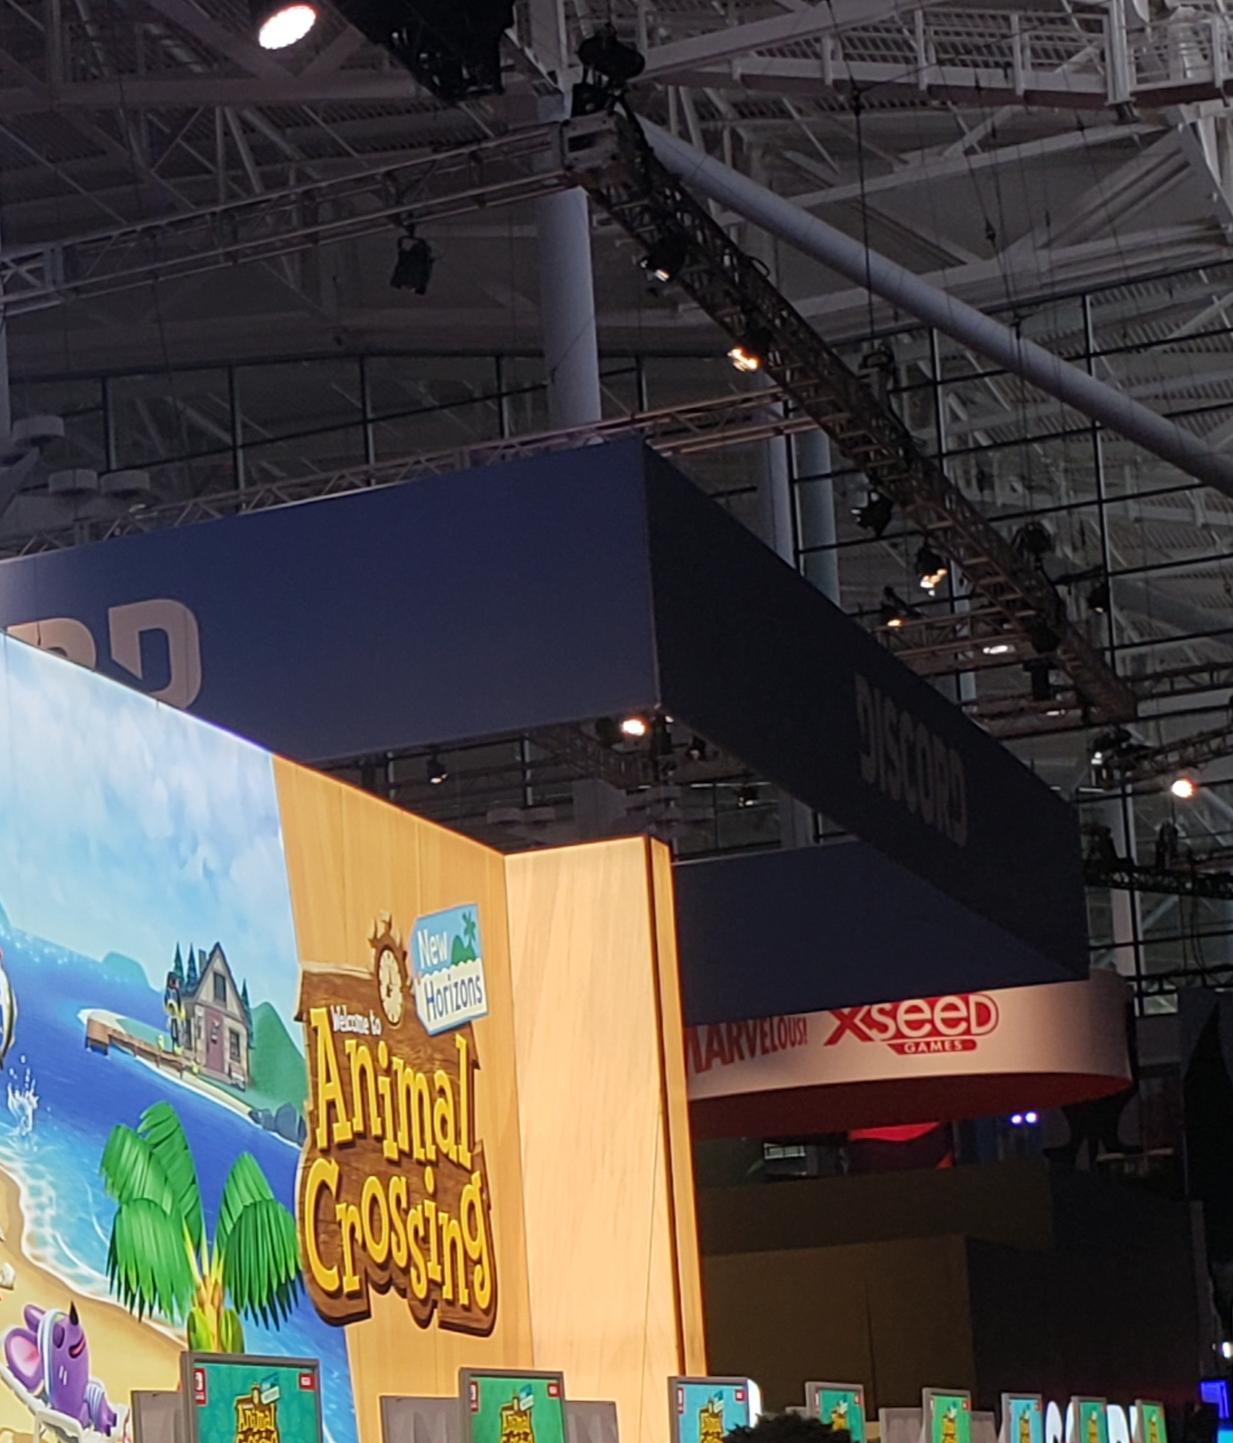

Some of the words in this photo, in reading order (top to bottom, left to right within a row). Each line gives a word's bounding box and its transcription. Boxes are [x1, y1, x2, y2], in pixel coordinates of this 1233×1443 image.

[417, 929, 448, 970] New
[330, 1004, 369, 1035] Welcome
[369, 1009, 382, 1036] to
[423, 973, 484, 1023] Horizons
[903, 1038, 964, 1054] GAMES
[309, 1006, 473, 1170] Animal
[304, 1169, 492, 1310] Crossing
